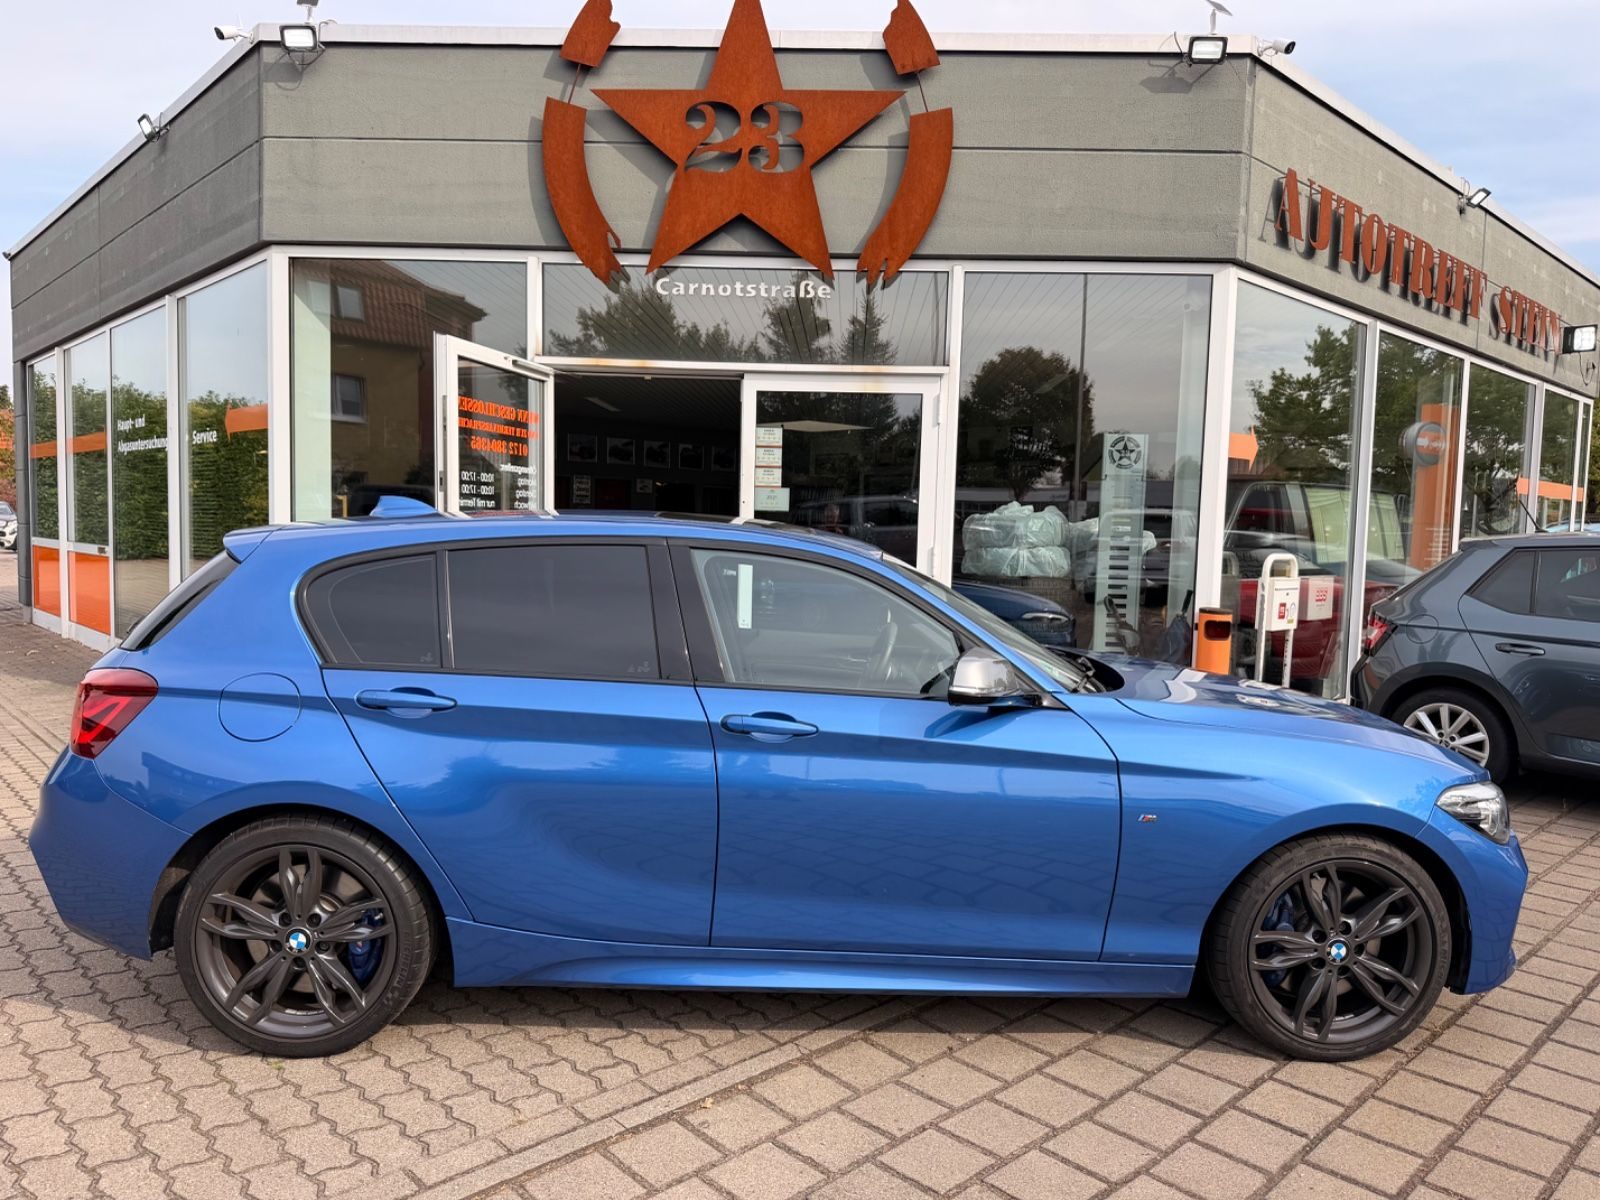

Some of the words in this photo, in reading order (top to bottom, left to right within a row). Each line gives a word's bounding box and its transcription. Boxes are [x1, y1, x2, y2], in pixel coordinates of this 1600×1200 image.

[684, 101, 804, 173] 23
[1274, 167, 1488, 320] AUTOTREFF
[655, 277, 831, 299] Carnotstraße
[192, 428, 217, 444] Service
